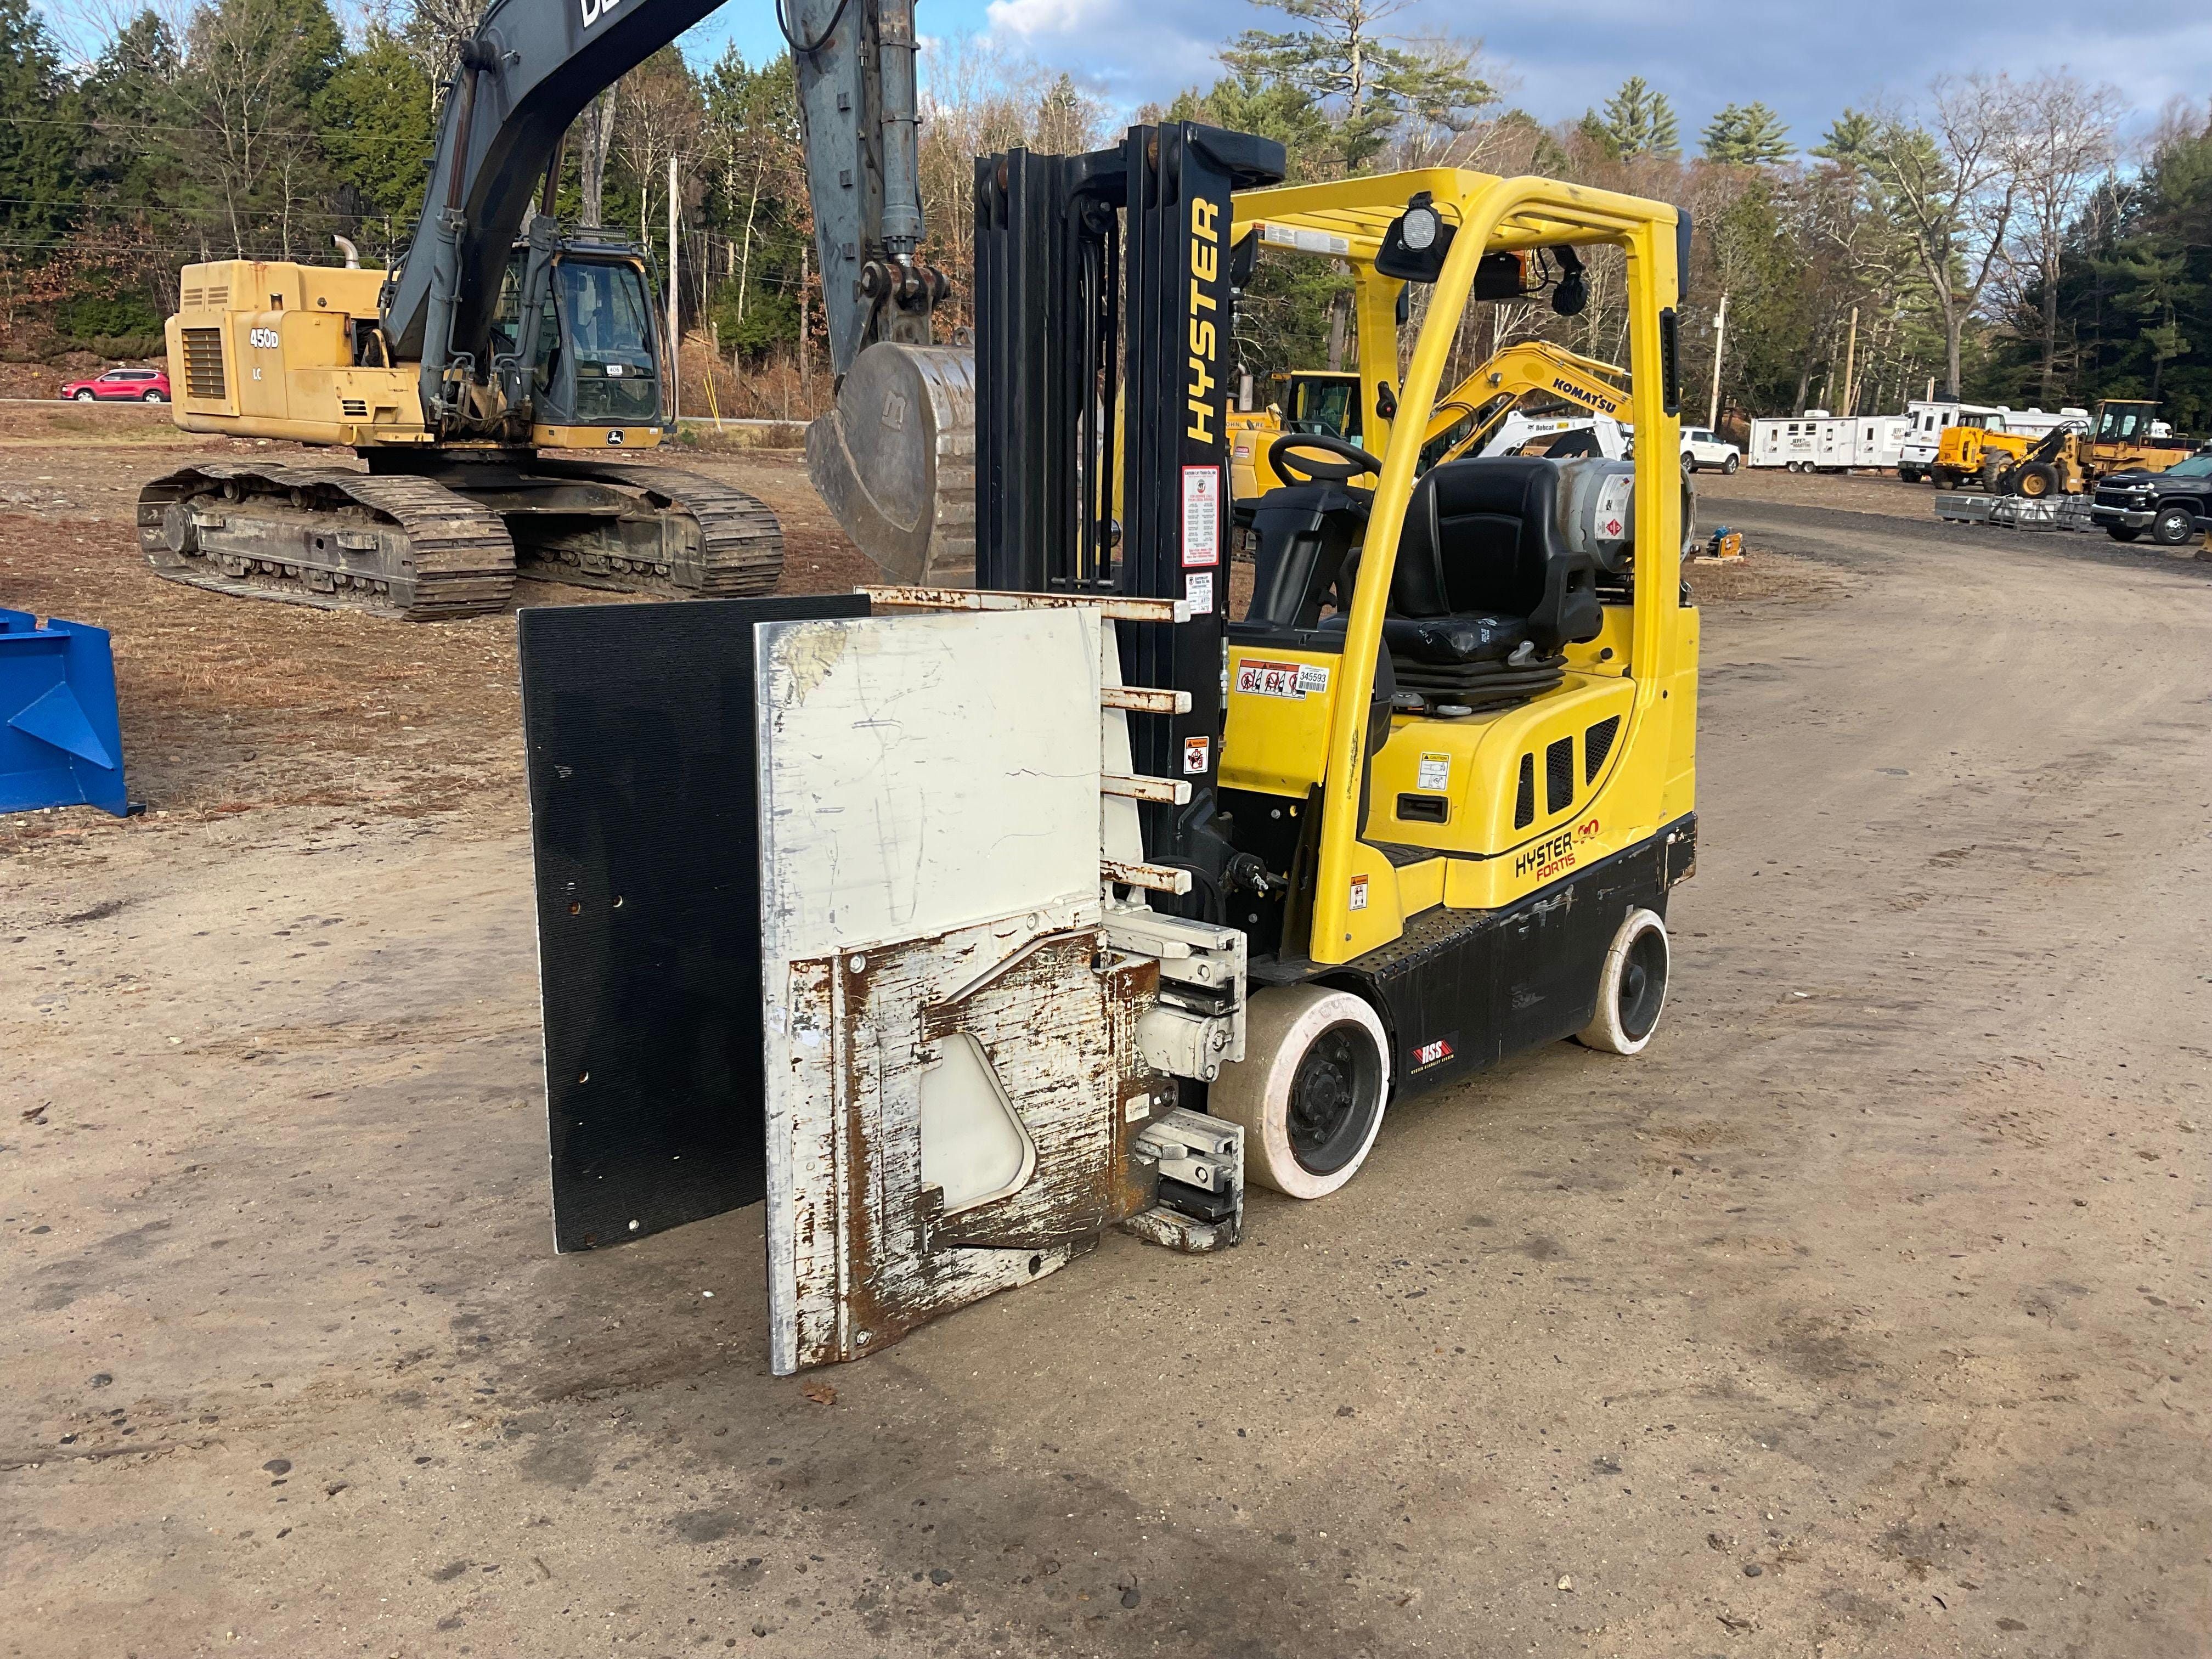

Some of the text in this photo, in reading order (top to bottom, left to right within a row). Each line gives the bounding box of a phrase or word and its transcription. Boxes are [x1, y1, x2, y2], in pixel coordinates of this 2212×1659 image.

[1187, 197, 1218, 444] HYSTER
[250, 327, 279, 348] 450D
[253, 367, 262, 380] LC
[1553, 377, 1617, 413] KOMATSU
[1300, 672, 1326, 682] 345593
[1516, 832, 1572, 878] HYSTER
[1537, 853, 1576, 882] FORTIS
[1423, 1040, 1442, 1064] HSS
